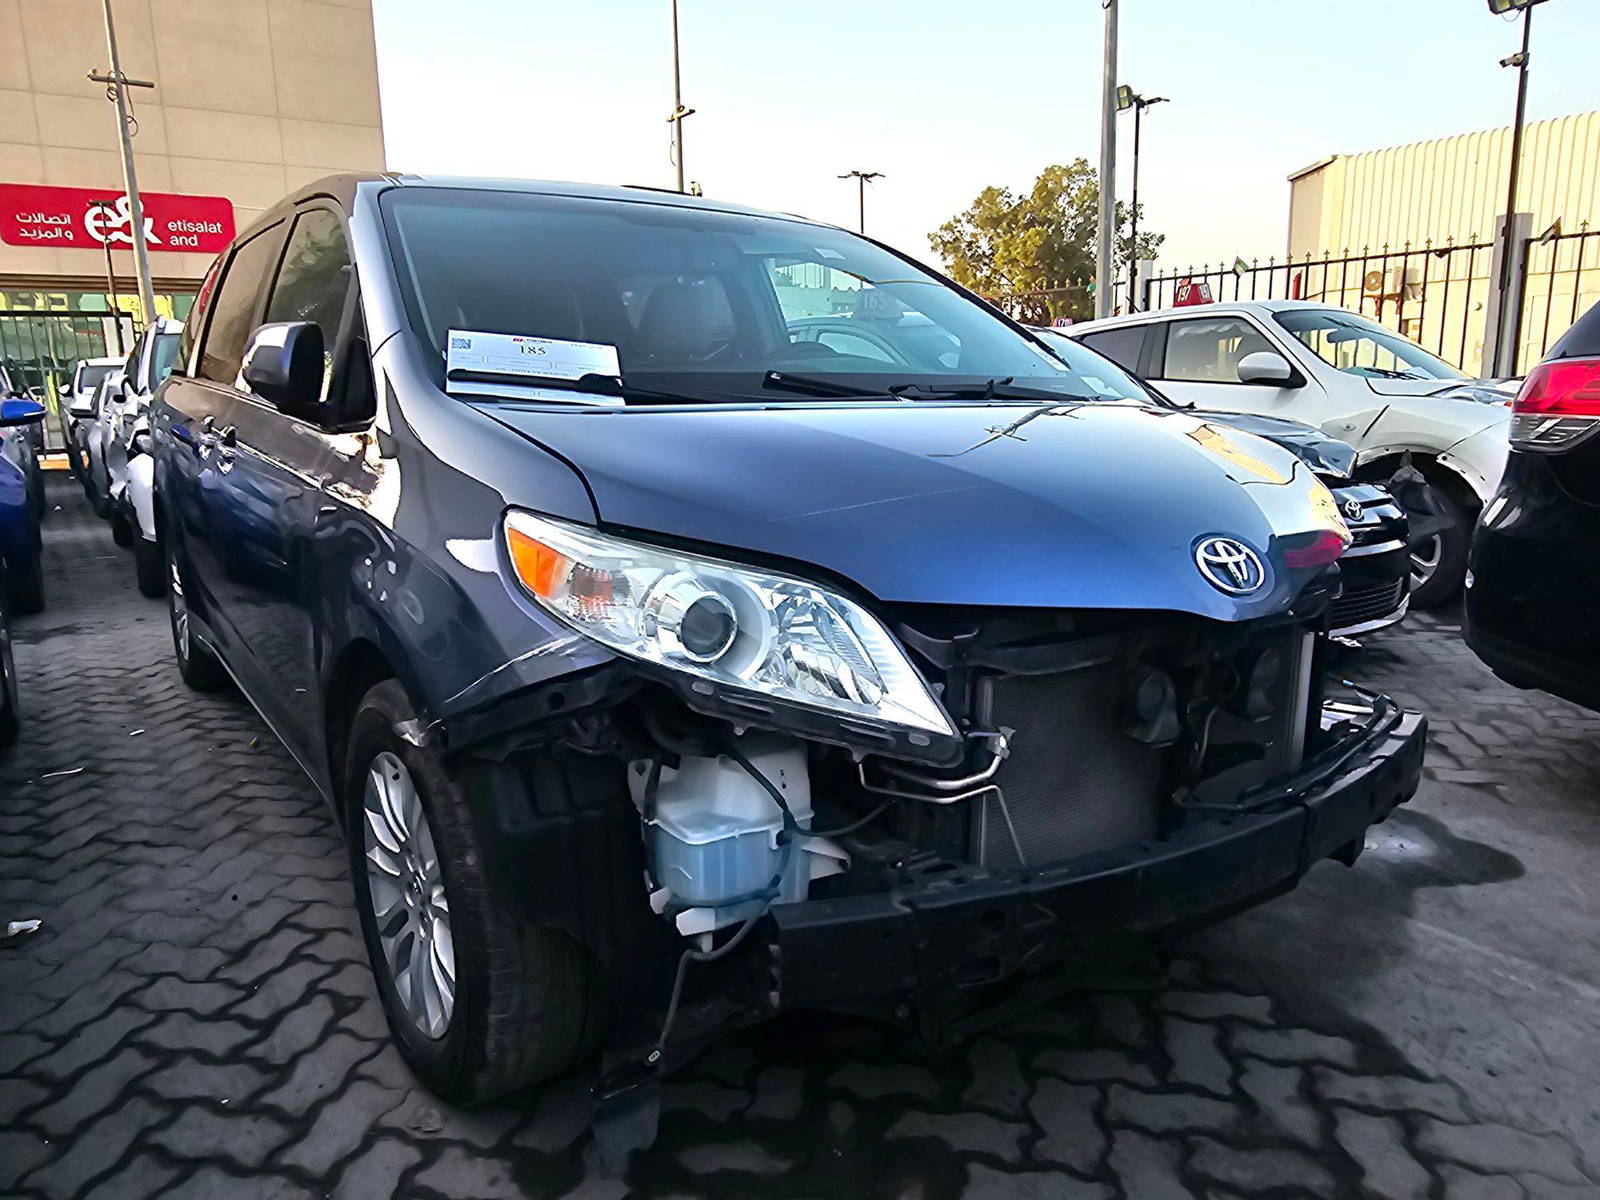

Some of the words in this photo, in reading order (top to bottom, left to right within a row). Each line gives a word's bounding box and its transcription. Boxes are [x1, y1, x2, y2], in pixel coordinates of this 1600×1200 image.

[15, 212, 71, 225] اتصالات
[167, 220, 224, 234] etisalat
[169, 234, 199, 247] and
[1177, 285, 1191, 302] 197
[520, 345, 547, 356] 185
